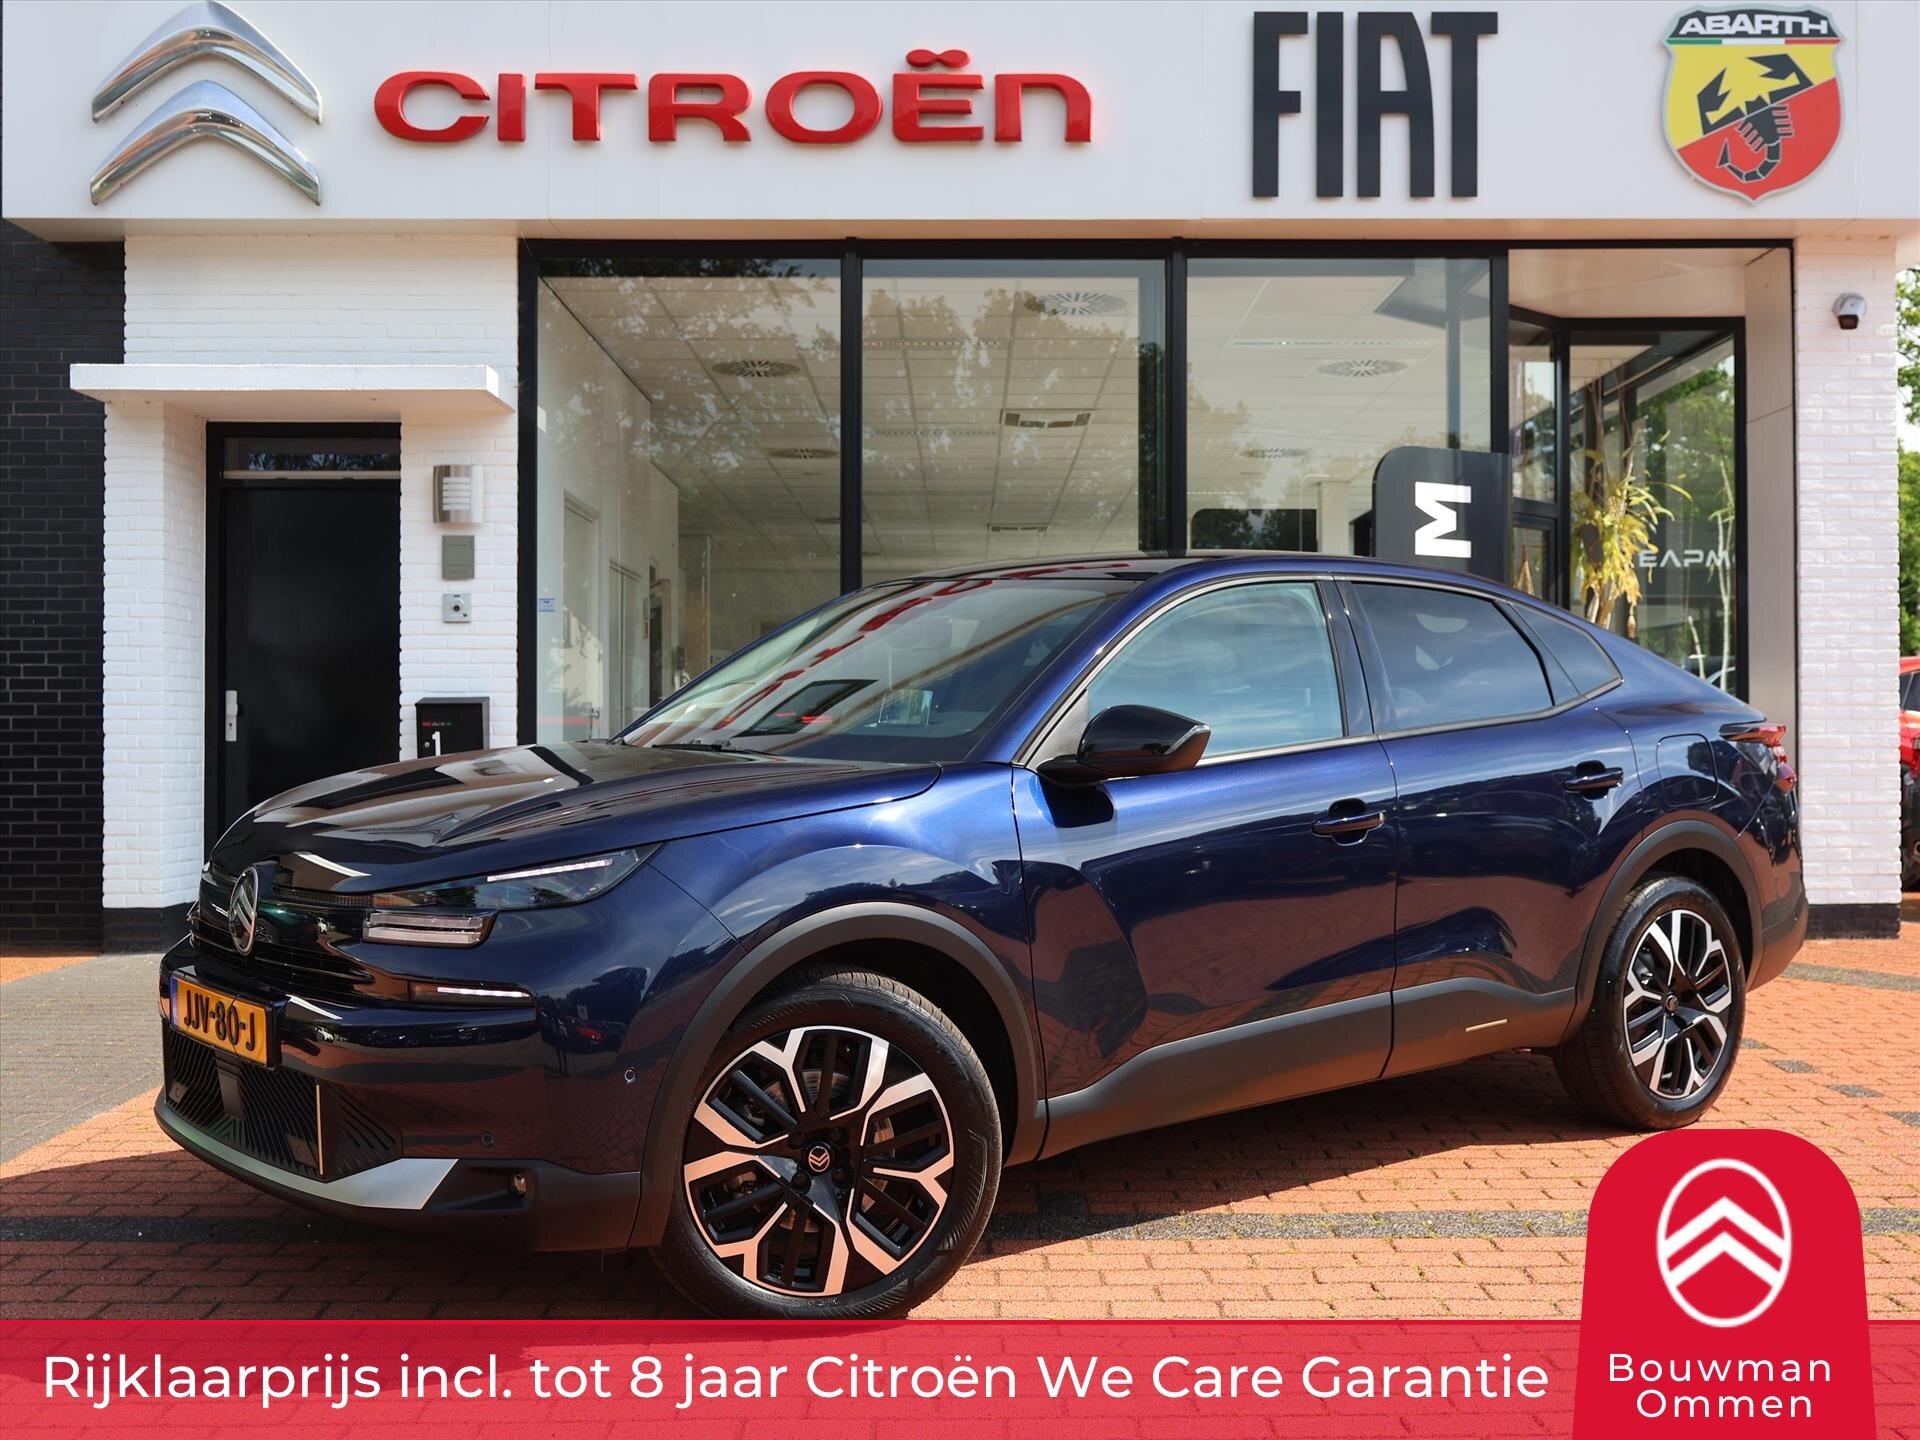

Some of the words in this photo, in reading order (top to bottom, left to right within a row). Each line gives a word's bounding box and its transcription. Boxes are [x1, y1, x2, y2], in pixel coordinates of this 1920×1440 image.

[1678, 14, 1828, 35] ABARTH
[375, 49, 1092, 143] CITROËN
[1253, 12, 1497, 198] FIAT
[1638, 548, 1735, 568] EAPM
[183, 989, 255, 1051] JJV-80-J
